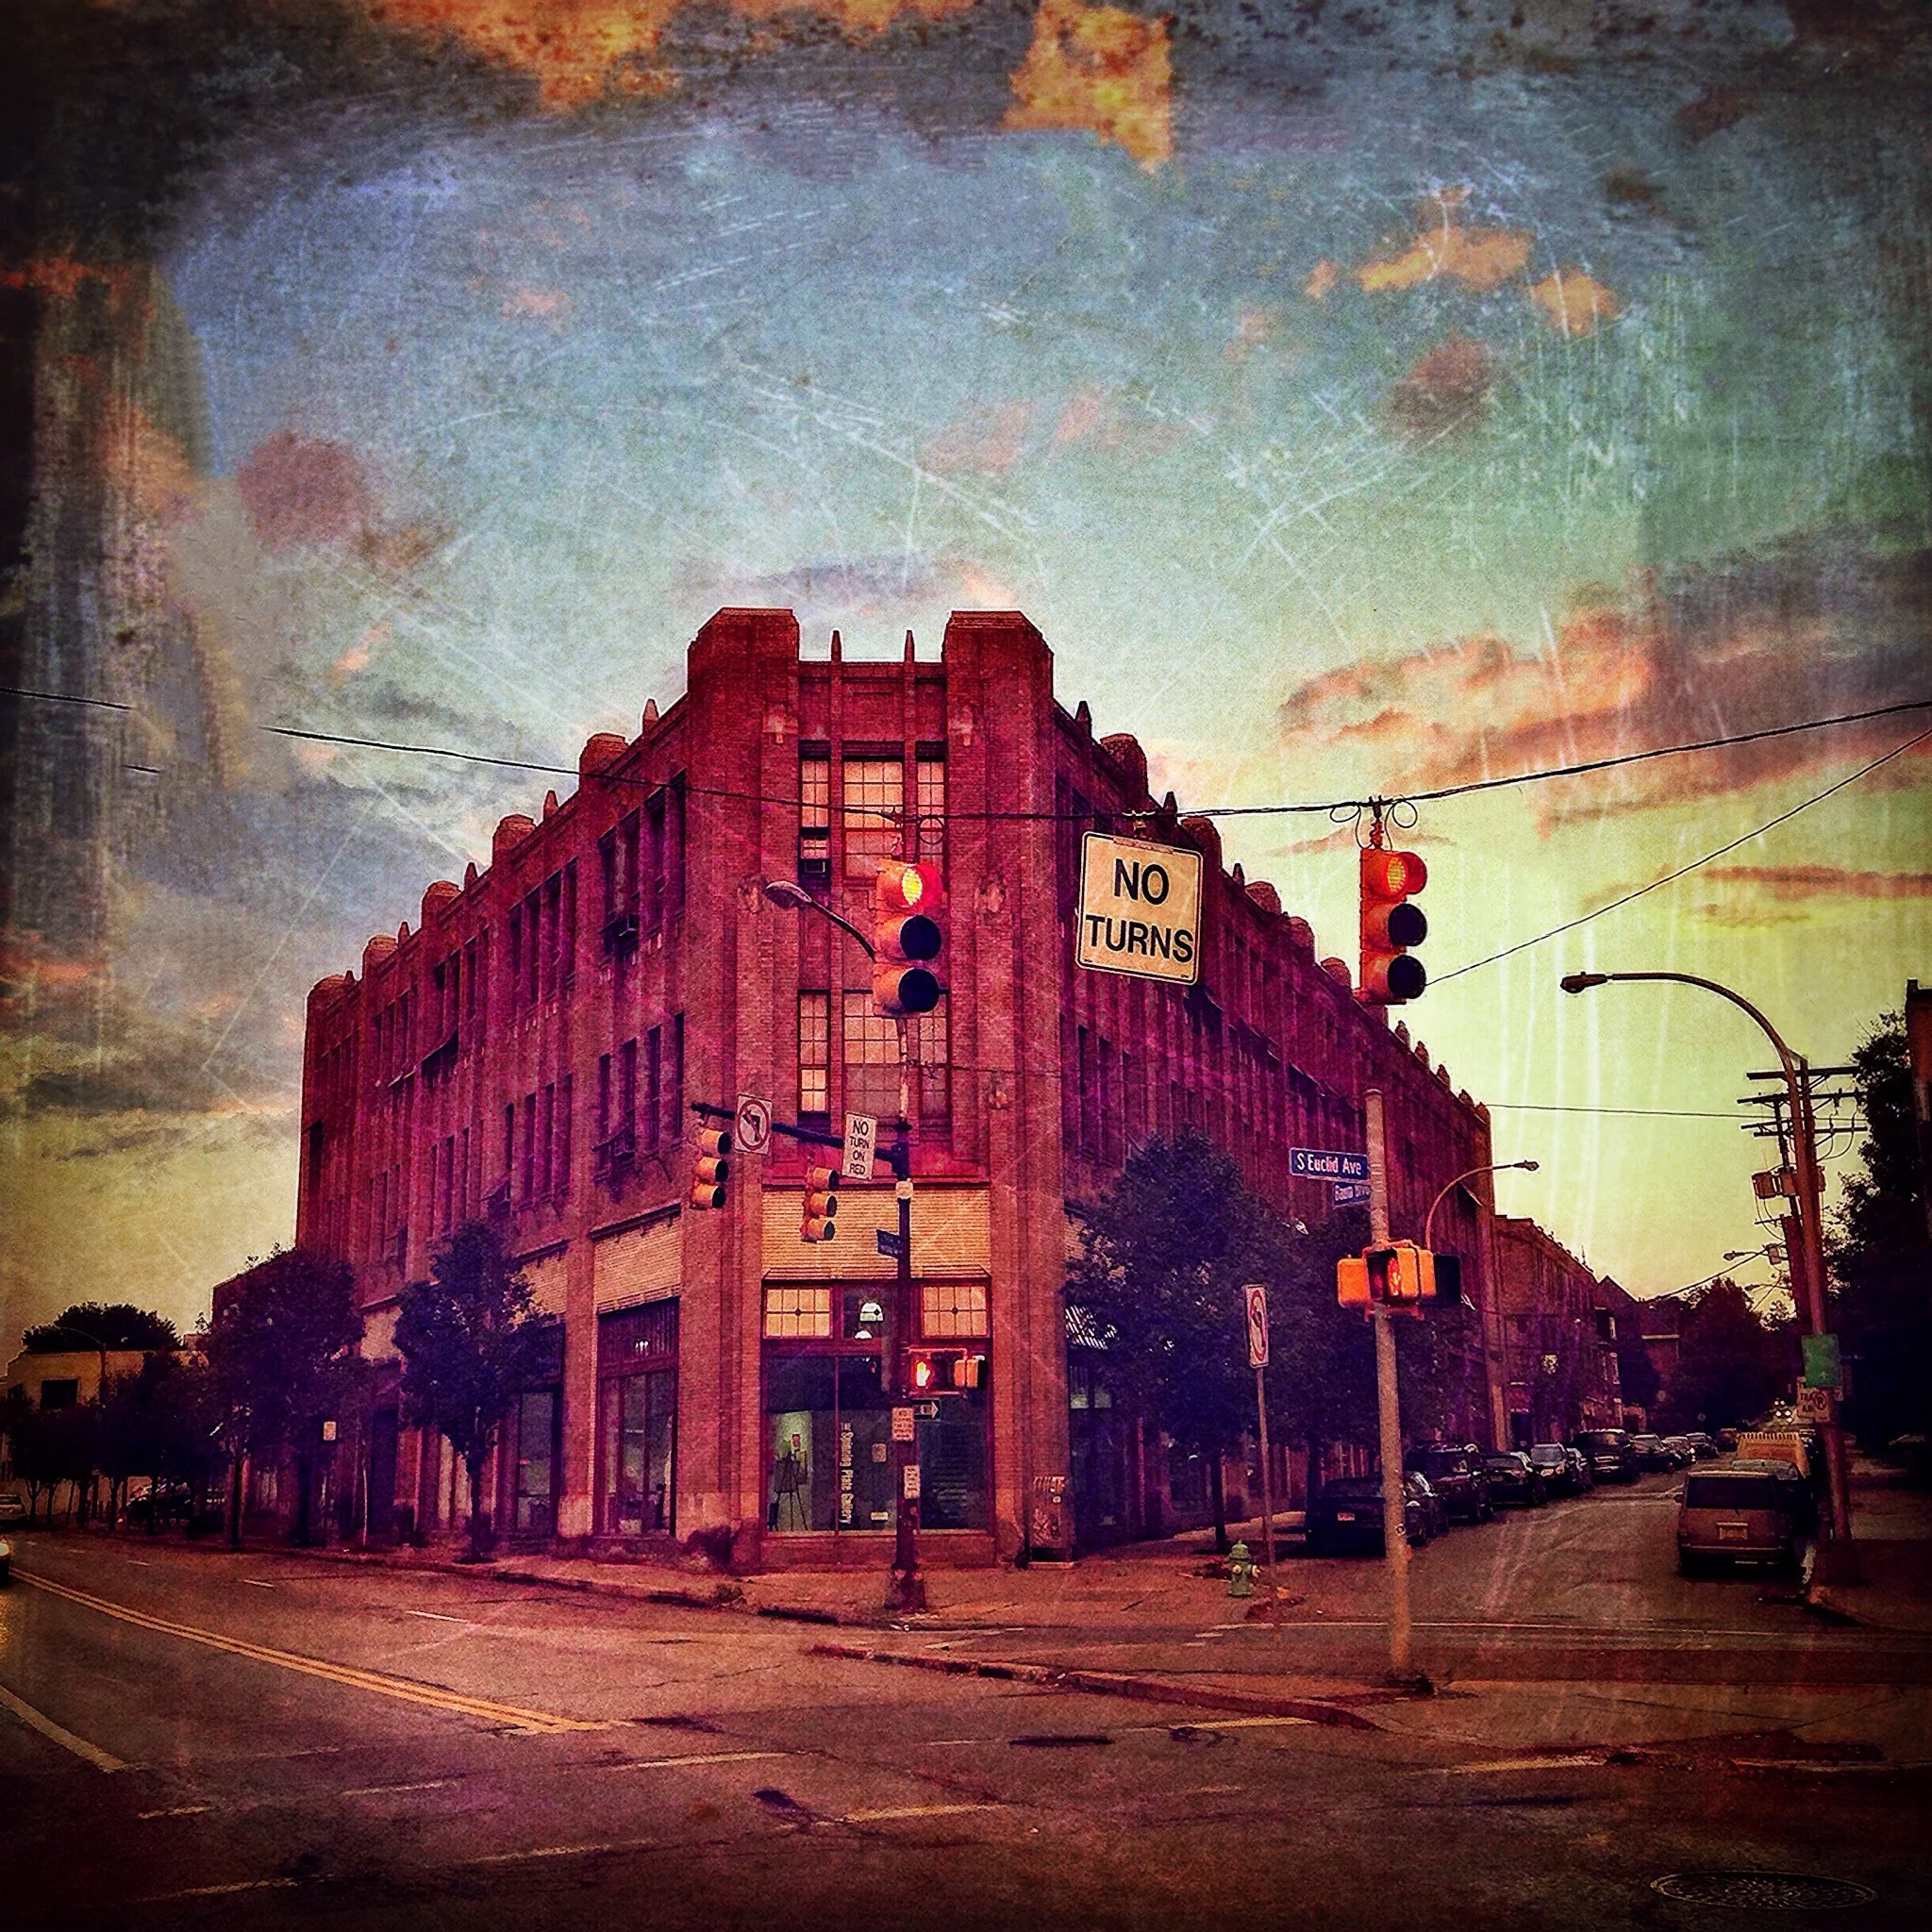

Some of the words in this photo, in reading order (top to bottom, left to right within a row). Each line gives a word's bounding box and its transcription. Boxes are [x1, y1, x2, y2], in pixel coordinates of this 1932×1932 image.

[1113, 858, 1170, 906] NO
[1085, 914, 1194, 963] TURNS
[852, 1119, 869, 1136] NO
[849, 1136, 870, 1149] TURN
[852, 1150, 866, 1162] ON
[1296, 1152, 1306, 1171] S
[1307, 1153, 1339, 1174] Euclid
[1341, 1158, 1362, 1175] Ave
[849, 1163, 866, 1175] RED
